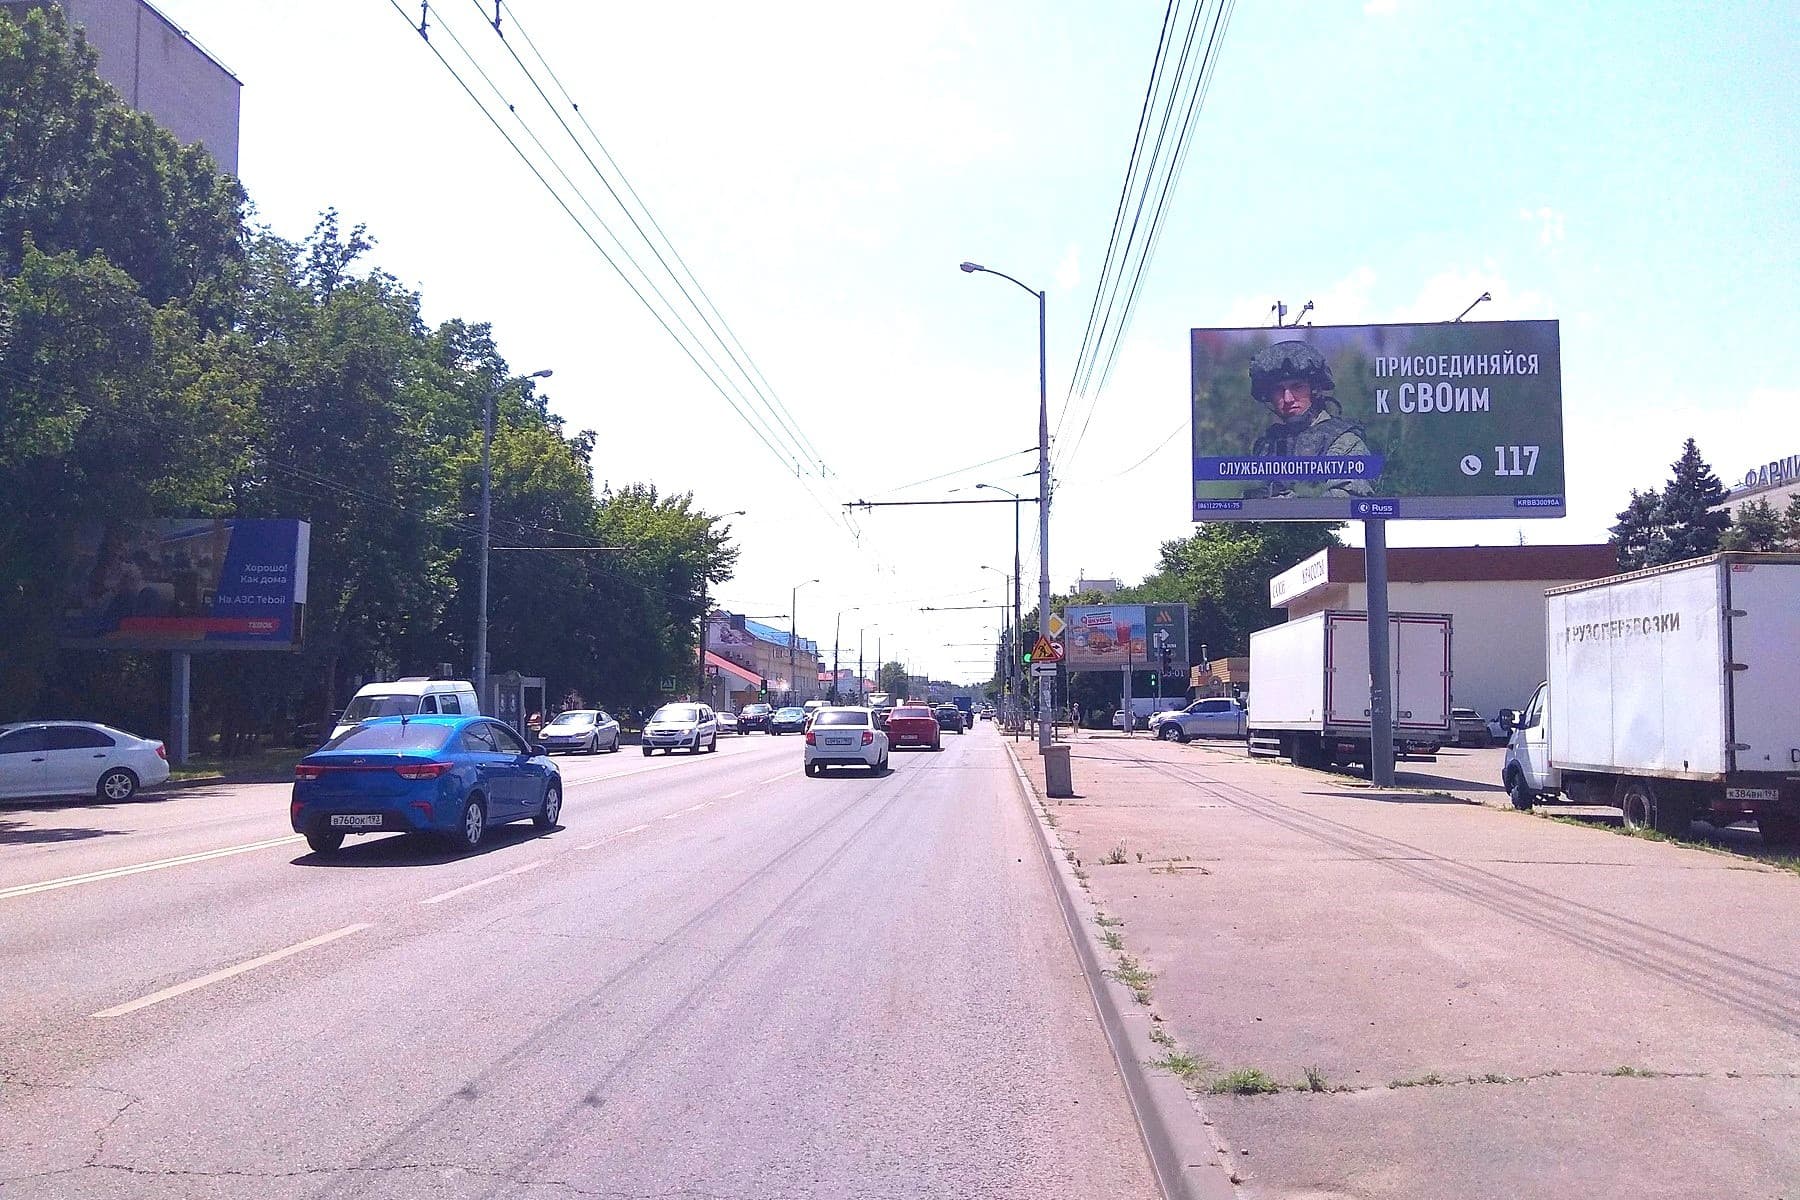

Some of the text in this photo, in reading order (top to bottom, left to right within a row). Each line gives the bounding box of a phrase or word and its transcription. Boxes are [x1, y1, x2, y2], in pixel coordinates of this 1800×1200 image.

[1375, 350, 1539, 378] ПРИСОЕДИНЯЙСЯ
[1494, 446, 1540, 476] 117
[1219, 460, 1365, 475] СЛУЖБАПОКОНТРАКТУ.РФ
[1371, 503, 1393, 512] Russ
[244, 563, 288, 573] Хорошо!
[240, 575, 287, 585] Как дома
[218, 595, 232, 604] На
[233, 595, 255, 604] АЗС
